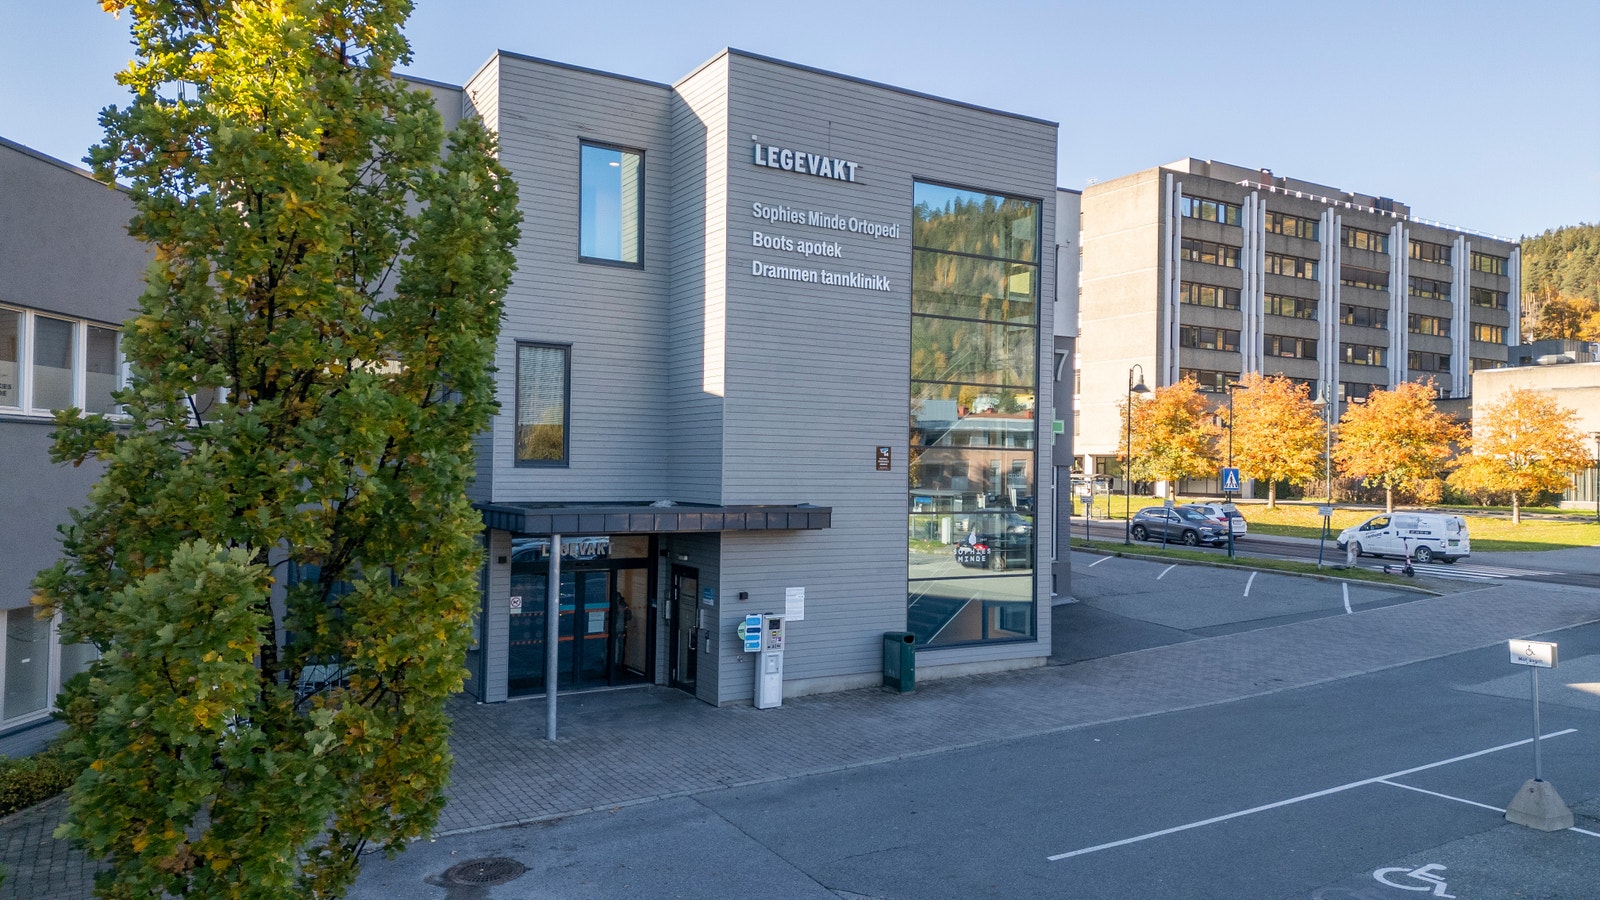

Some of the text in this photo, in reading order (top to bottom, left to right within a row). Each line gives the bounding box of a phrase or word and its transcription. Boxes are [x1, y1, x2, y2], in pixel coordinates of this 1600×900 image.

[755, 143, 858, 182] LEGEVAKT
[752, 202, 900, 239] Sophies Minde Ortopedi
[752, 231, 842, 257] Boots apotek
[752, 260, 891, 292] Drammen tannklinikk
[542, 543, 614, 557] LGEVAKT
